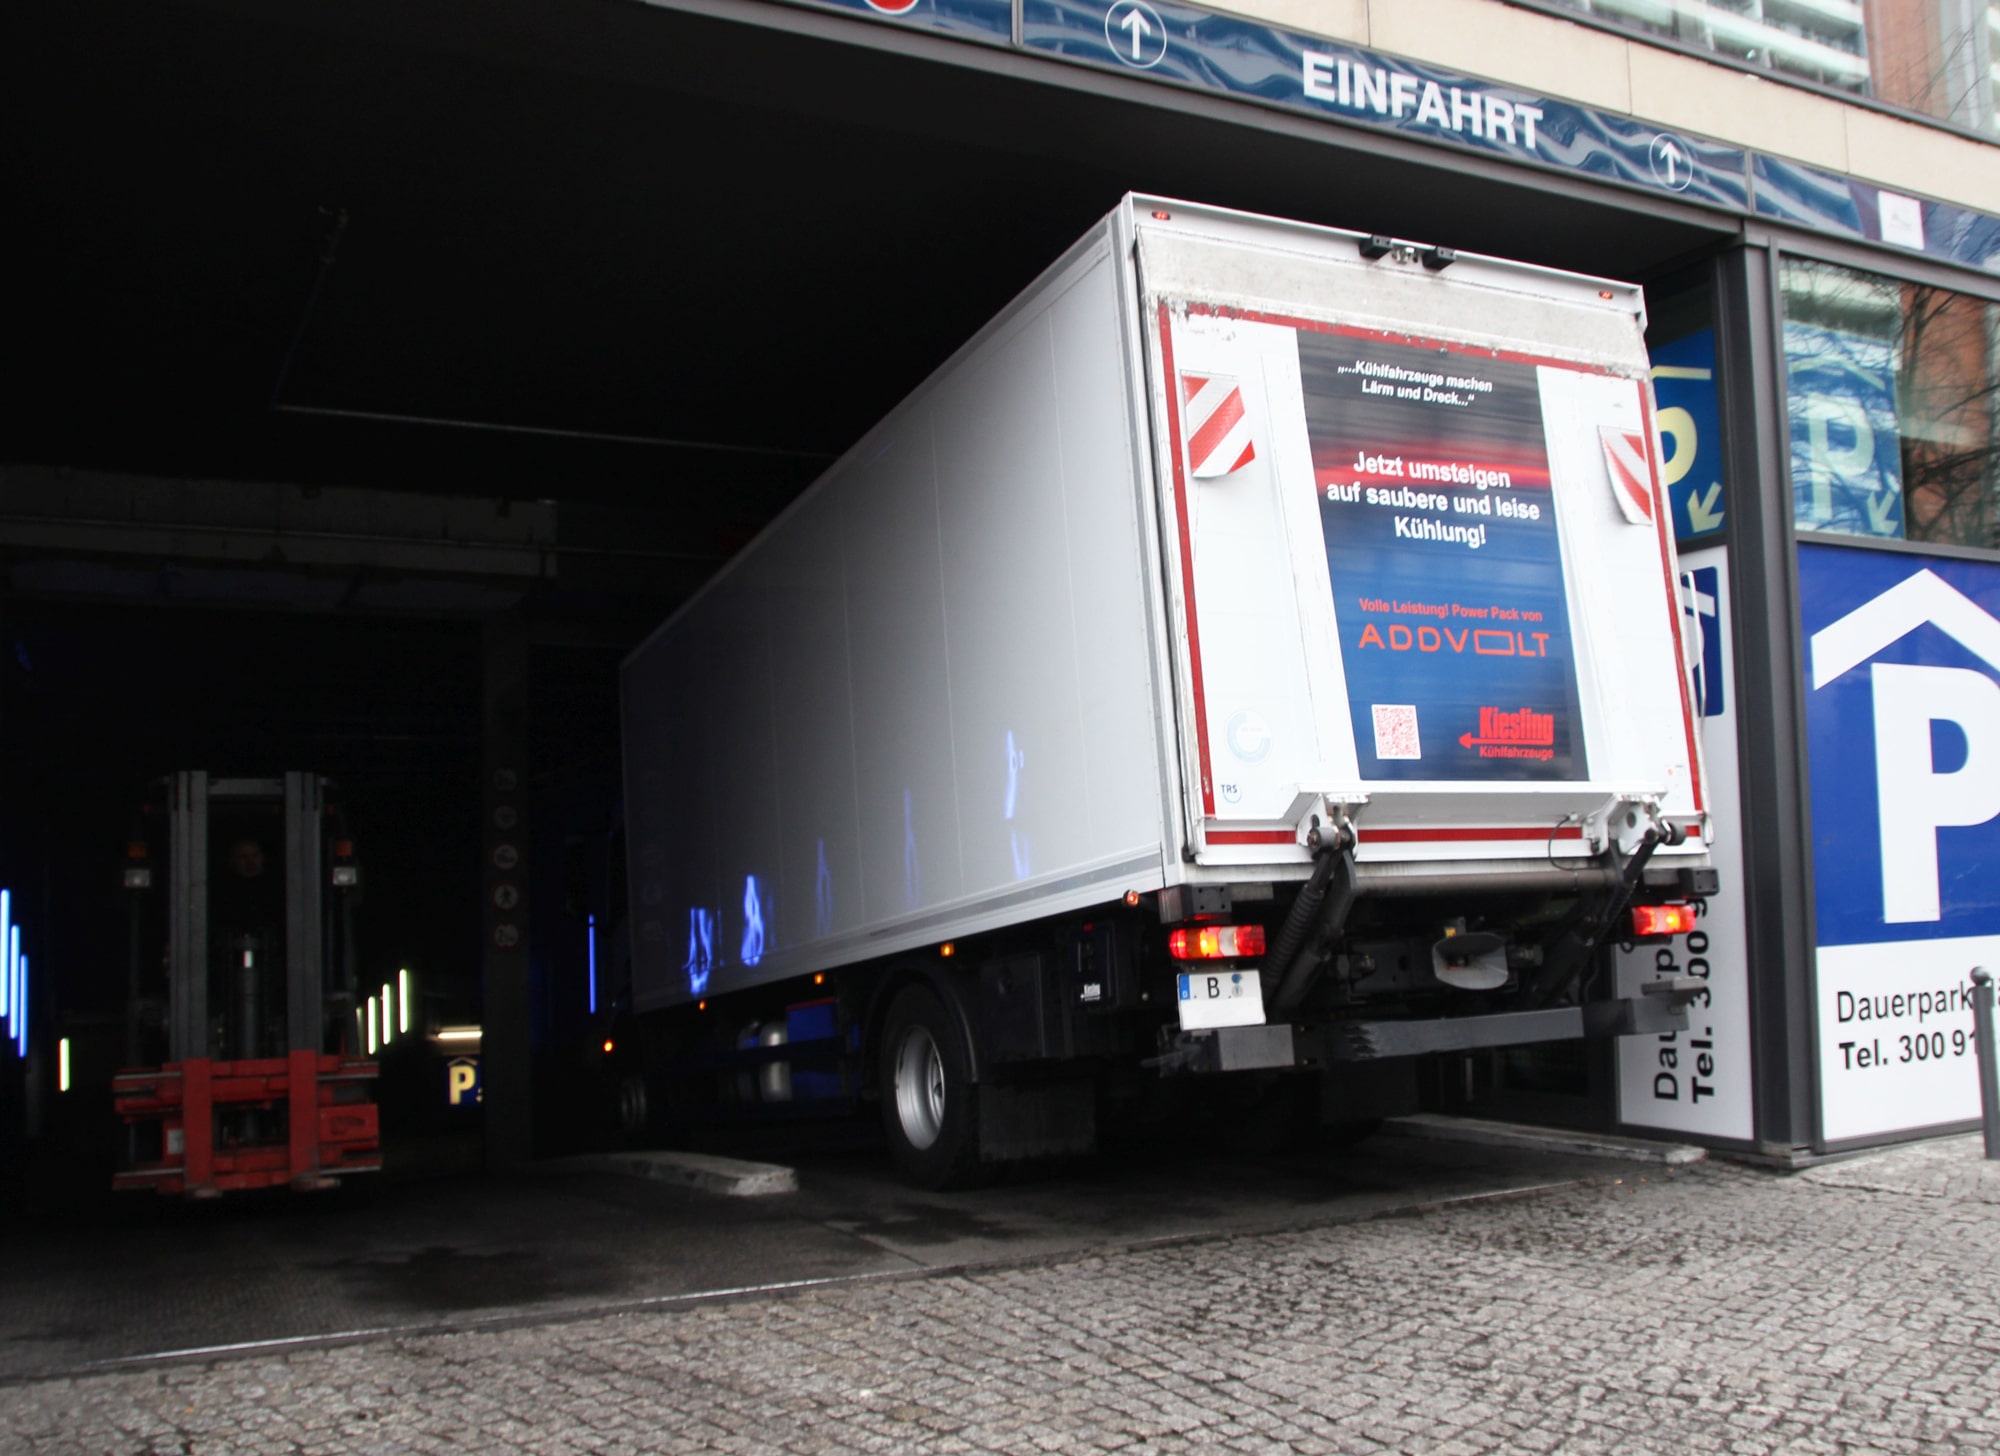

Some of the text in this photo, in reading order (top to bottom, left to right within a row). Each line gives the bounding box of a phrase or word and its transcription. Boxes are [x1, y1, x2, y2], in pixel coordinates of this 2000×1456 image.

[1302, 50, 1545, 150] EINFAHRT
[1361, 378, 1395, 397] Lärm
[1397, 385, 1421, 400] und
[1446, 376, 1493, 392] machen
[1353, 451, 1511, 490] Jetzt umsteigen
[1327, 482, 1540, 520] auf saubere und leise
[1394, 516, 1487, 549] Kühlung!
[1358, 598, 1543, 622] Volle Leistung! Power Pack von
[1358, 623, 1551, 657] ADDVOLT
[1479, 706, 1554, 743] Kiesling
[1479, 746, 1555, 762] Kühlfahrzeuge
[1220, 784, 1238, 794] TRS
[1871, 663, 2000, 924] P
[1206, 977, 1220, 999] B
[1691, 1026, 1715, 1104] Tel.
[1839, 1040, 1888, 1071] Tel.
[1899, 1032, 1946, 1064] 300
[449, 1065, 477, 1105] P
